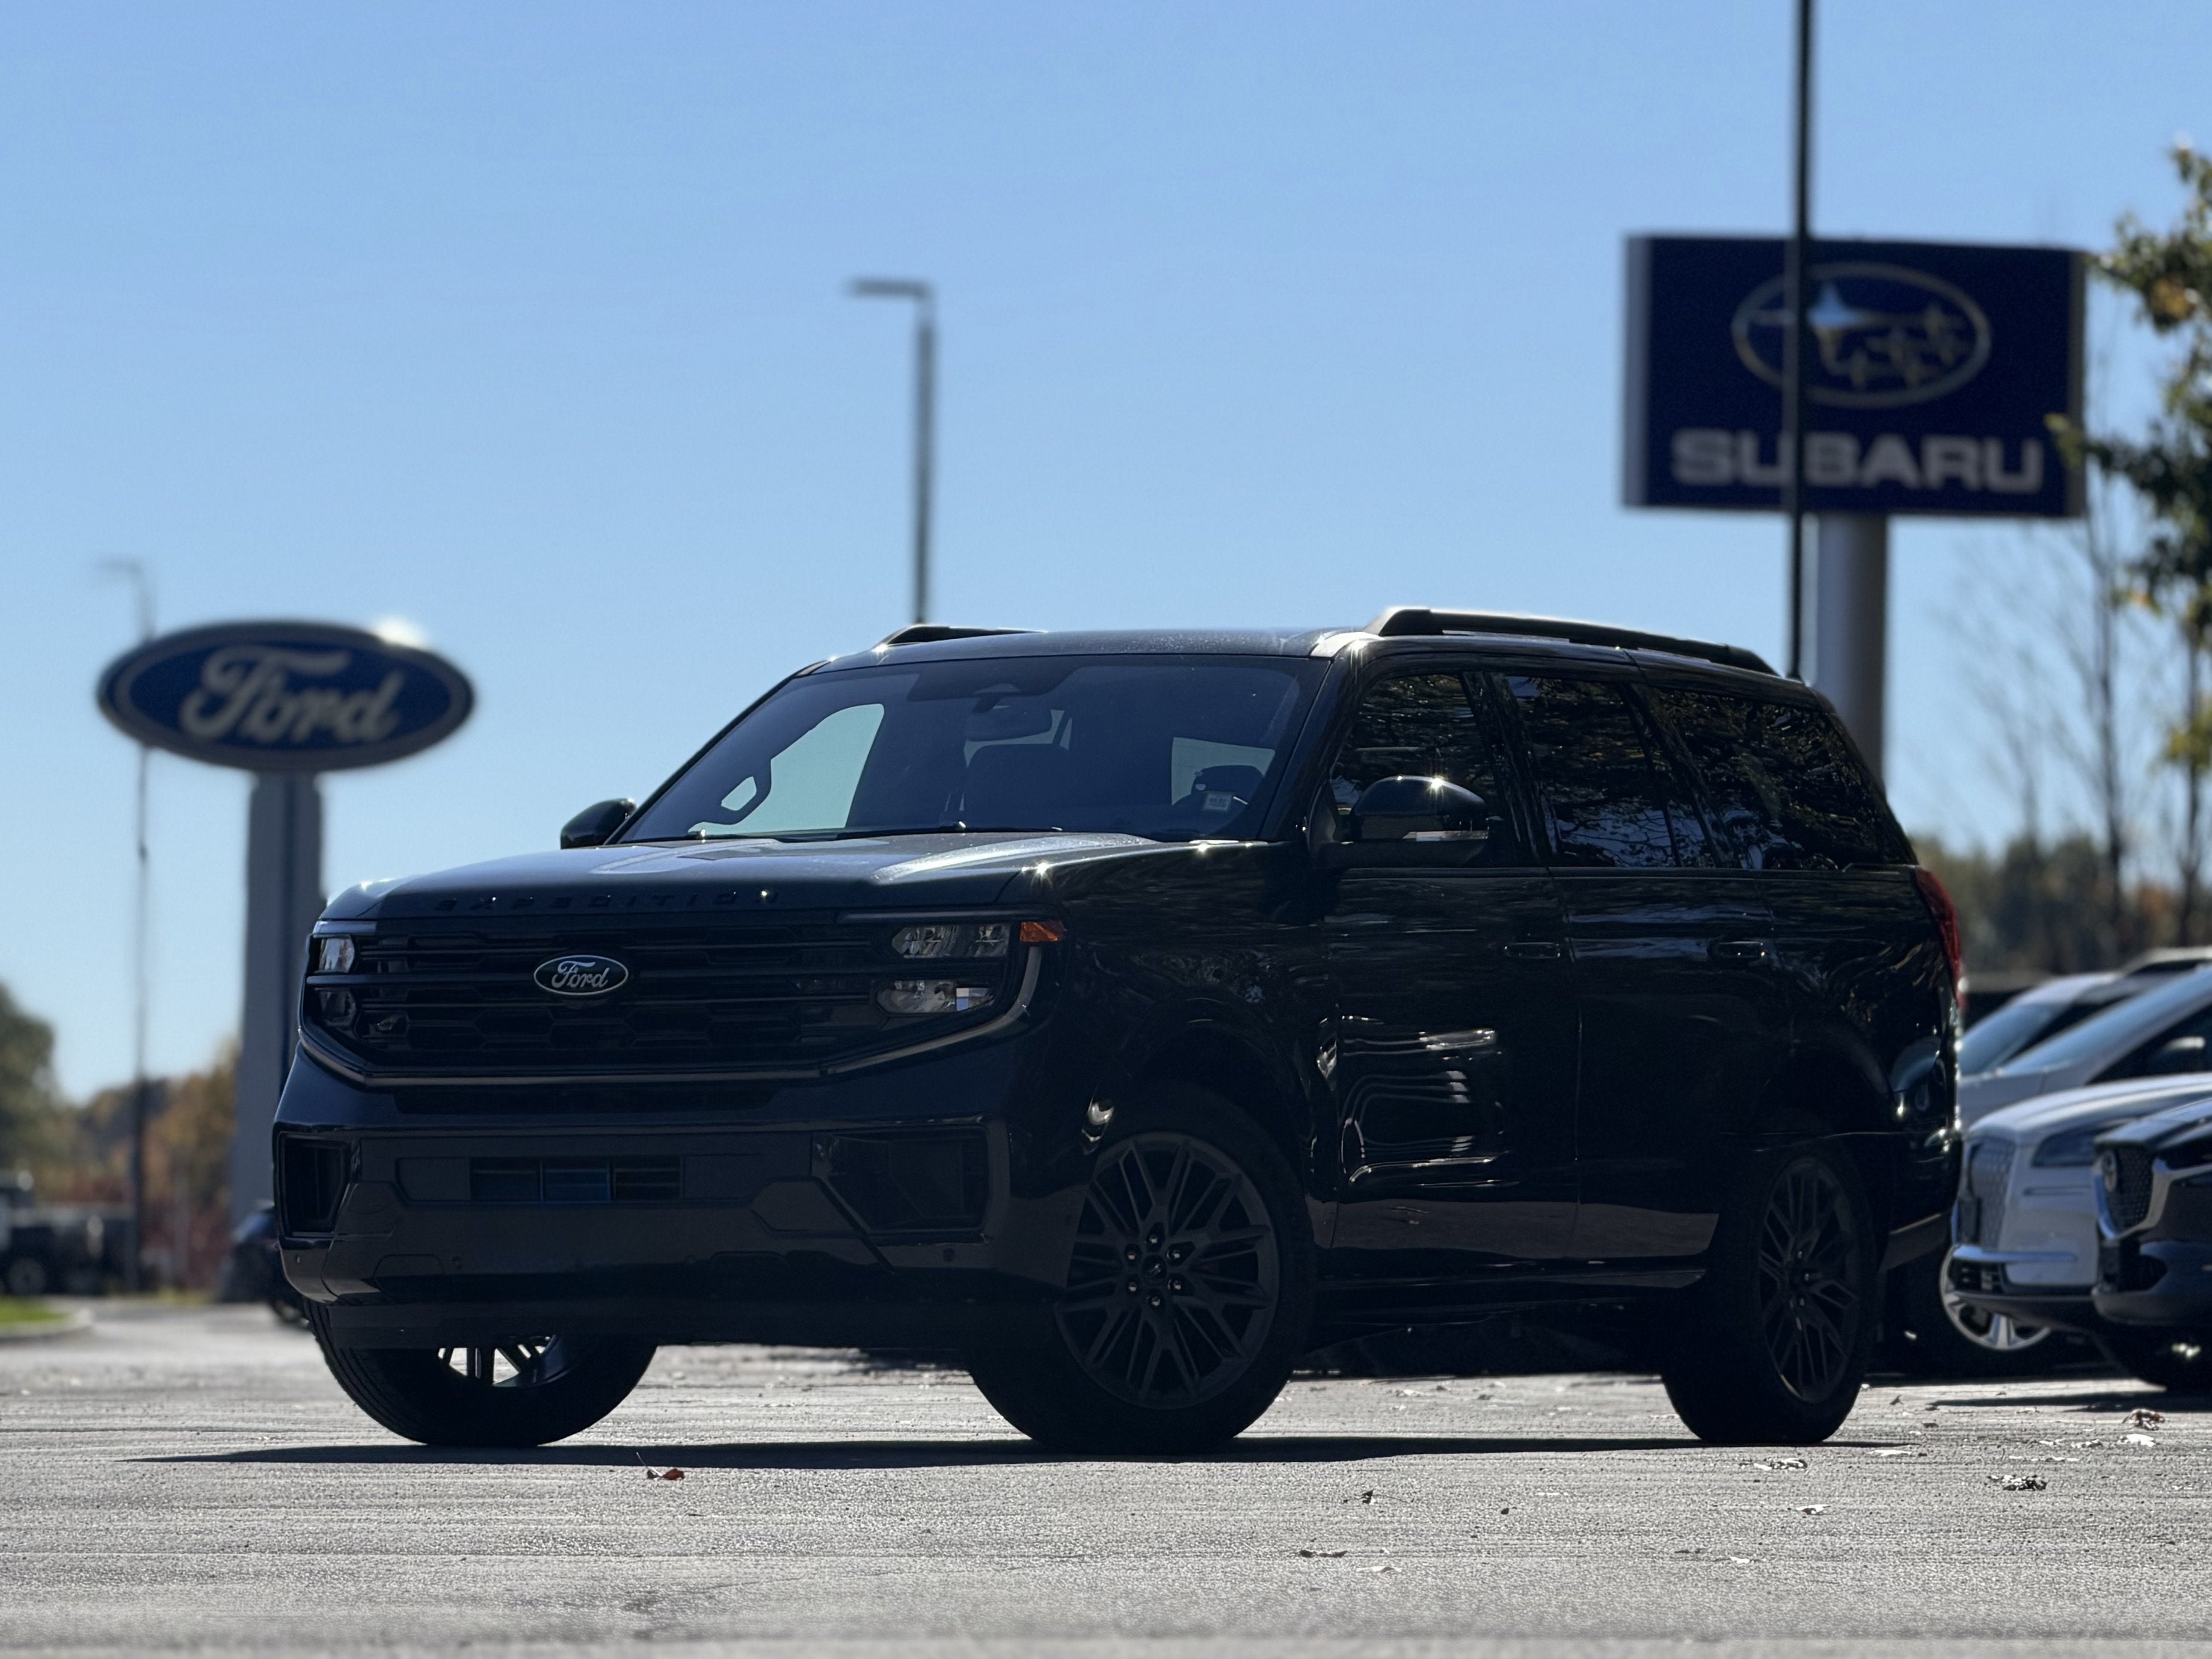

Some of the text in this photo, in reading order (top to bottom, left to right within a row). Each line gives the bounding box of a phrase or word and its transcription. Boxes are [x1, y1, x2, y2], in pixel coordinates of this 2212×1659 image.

[1671, 428, 2044, 493] SUBARU
[180, 644, 405, 742] Ford
[434, 890, 781, 912] EXPEDITION
[551, 960, 610, 988] Ford
